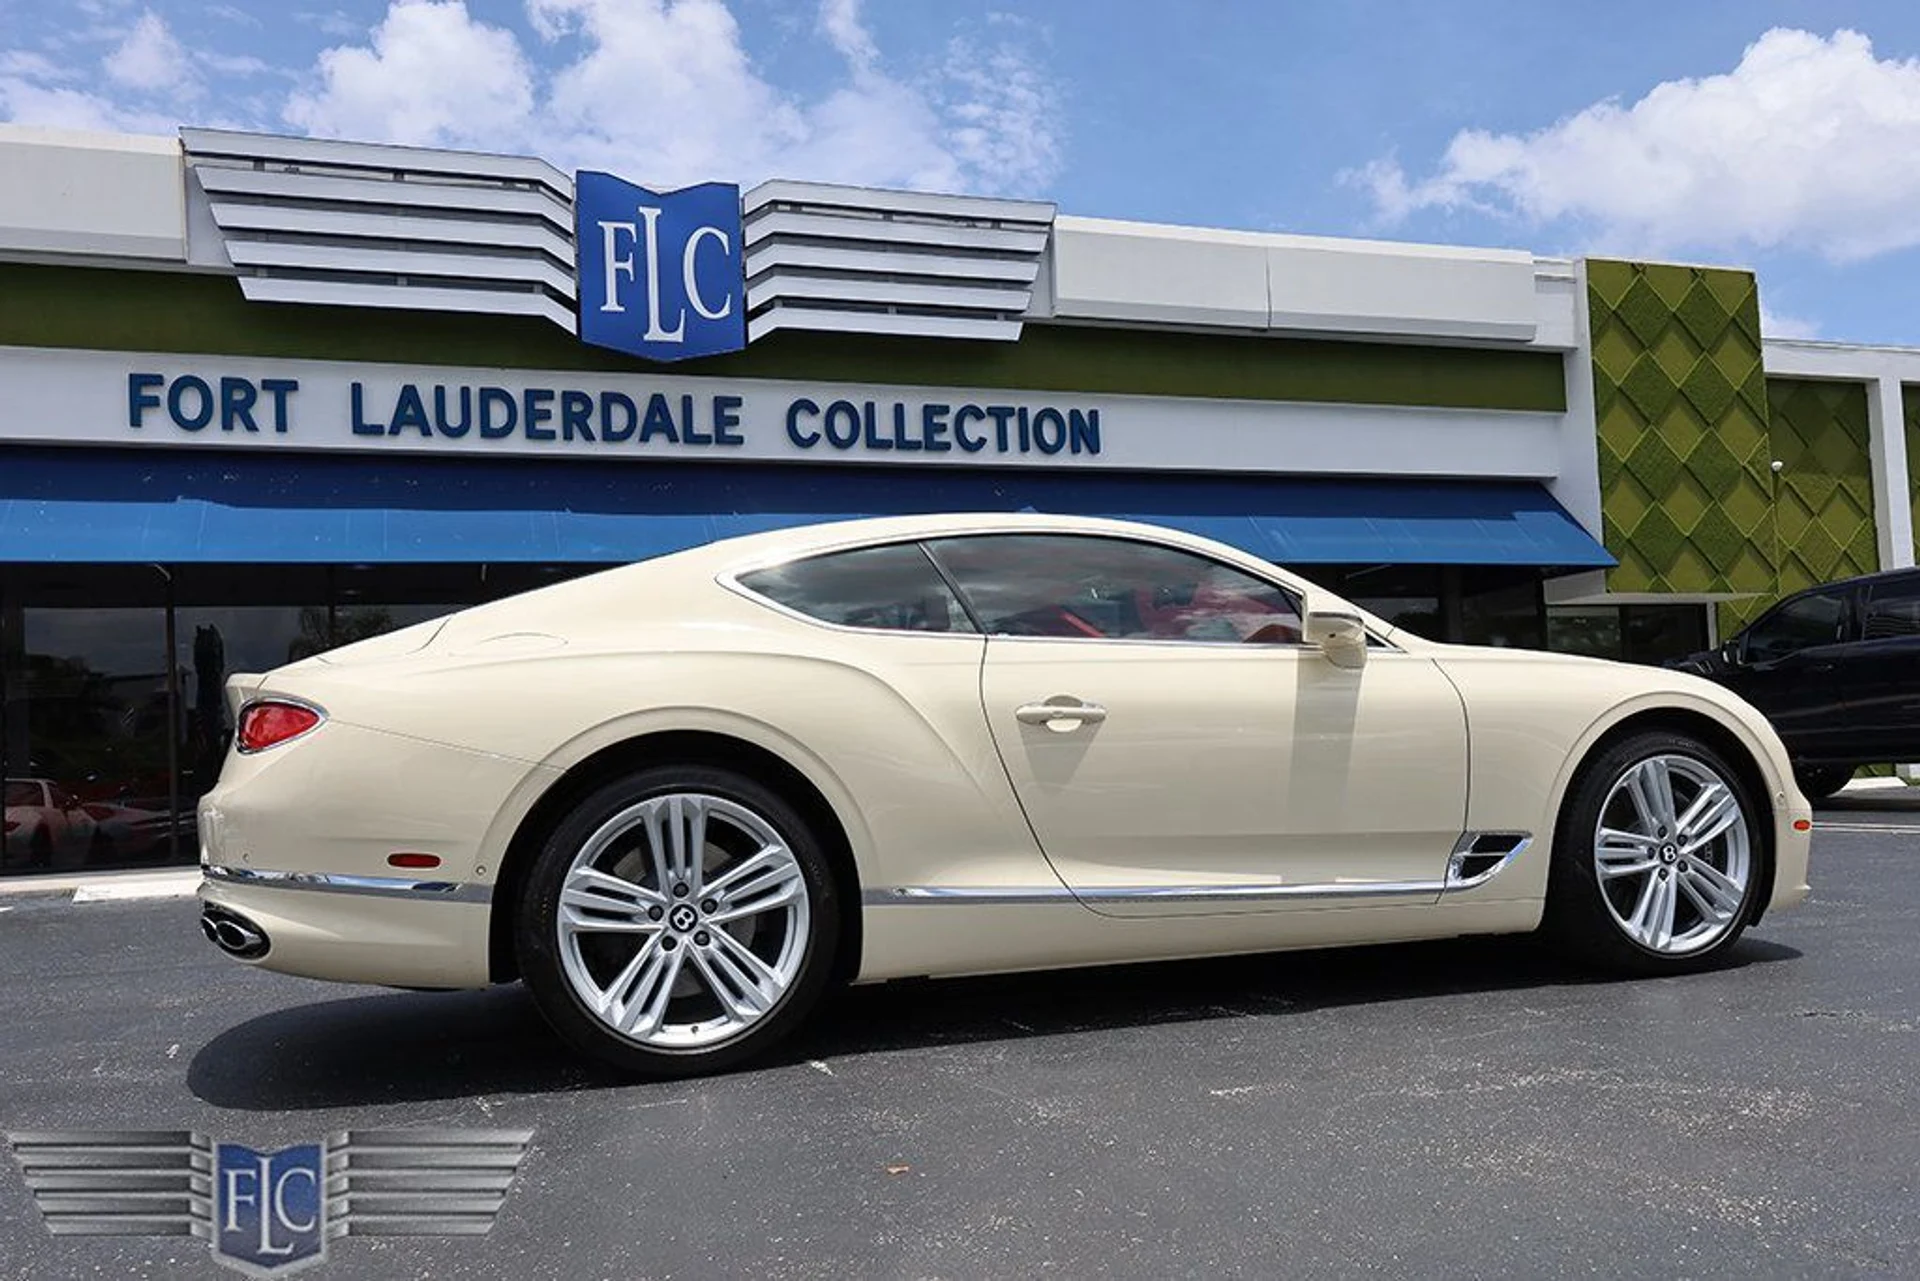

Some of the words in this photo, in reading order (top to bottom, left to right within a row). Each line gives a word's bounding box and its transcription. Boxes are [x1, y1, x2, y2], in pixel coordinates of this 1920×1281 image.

[598, 206, 731, 342] FLC
[129, 373, 298, 433] FORT
[351, 381, 744, 445] LAUDERDALE
[786, 398, 1100, 455] COLLECTION
